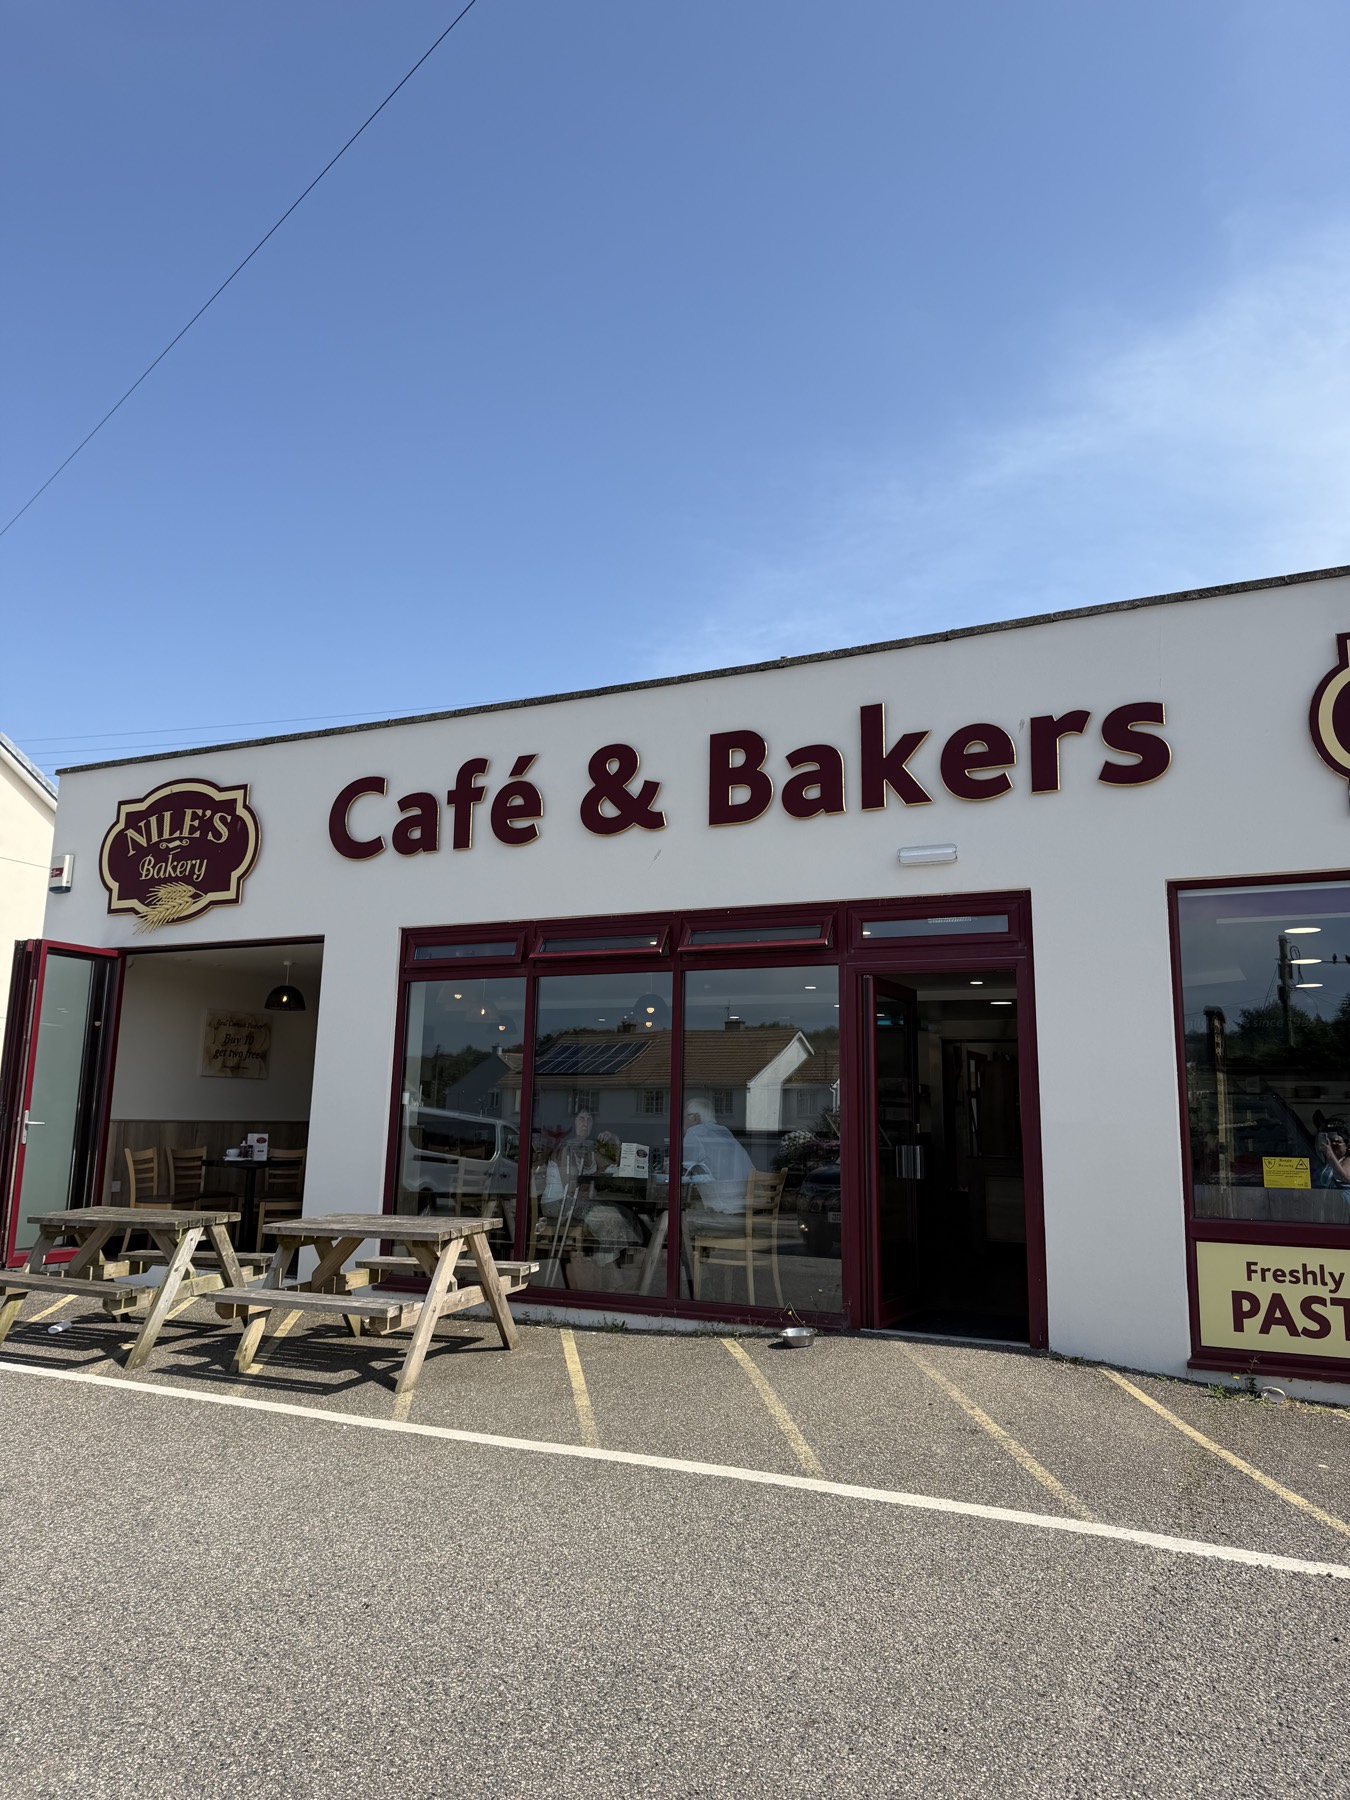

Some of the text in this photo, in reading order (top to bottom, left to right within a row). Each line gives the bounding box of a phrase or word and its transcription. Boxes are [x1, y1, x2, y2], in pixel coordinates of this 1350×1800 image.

[328, 701, 1173, 861] Café & Bakers
[124, 808, 232, 857] NILE'S
[139, 849, 208, 882] Bakery
[213, 1048, 260, 1061] get two free
[224, 1033, 255, 1047] Buy 10
[1245, 1261, 1345, 1294] Freshly
